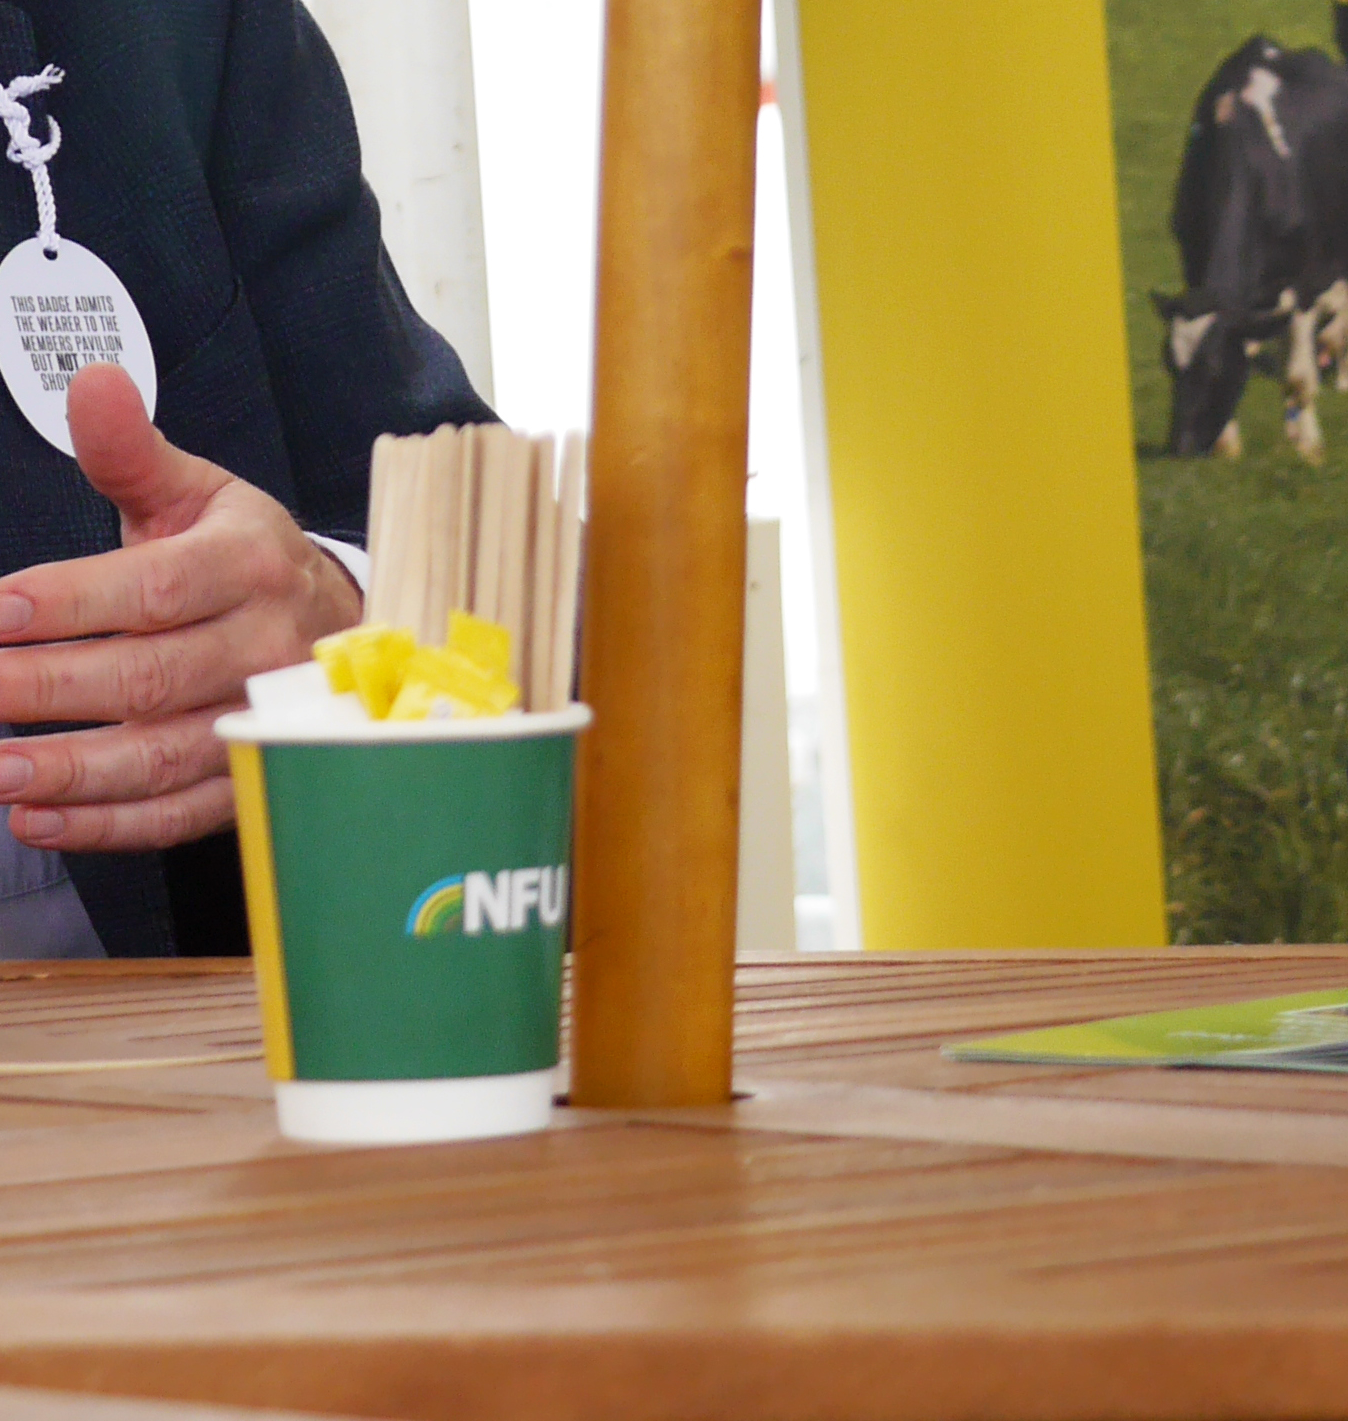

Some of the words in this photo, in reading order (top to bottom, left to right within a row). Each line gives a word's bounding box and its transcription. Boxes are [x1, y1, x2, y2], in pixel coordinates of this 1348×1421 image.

[10, 295, 36, 313] THIS
[37, 295, 72, 313] BADGE
[74, 295, 115, 313] ADMITS
[14, 315, 35, 332] THE
[37, 315, 82, 332] WEARER
[83, 315, 98, 332] TO
[100, 315, 121, 332] THE
[21, 335, 74, 352] MEMBERS
[75, 335, 124, 352] PAVILION
[31, 353, 54, 372] BUT
[56, 353, 80, 372] NOT
[461, 863, 570, 936] NFU
